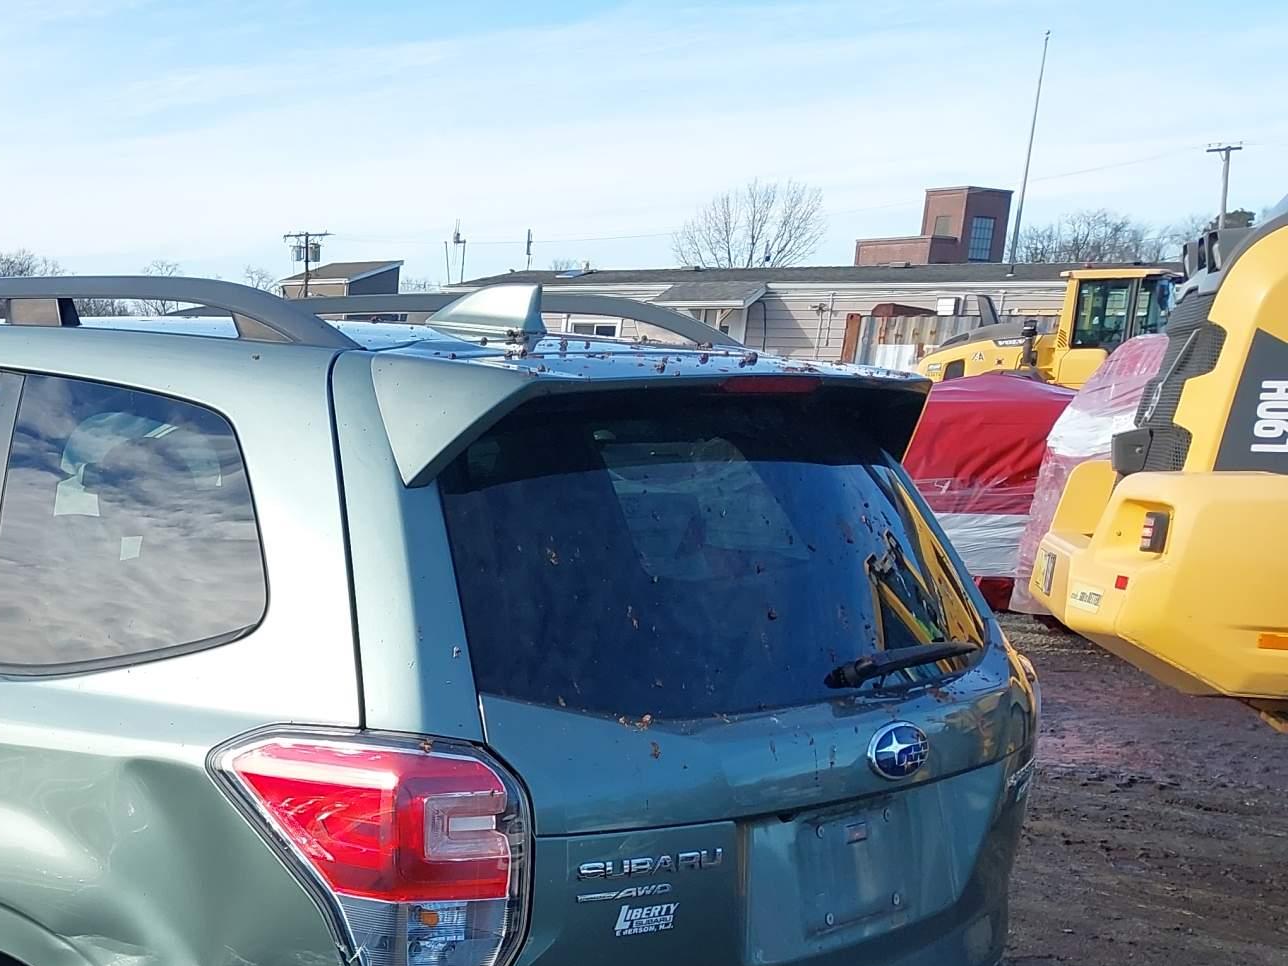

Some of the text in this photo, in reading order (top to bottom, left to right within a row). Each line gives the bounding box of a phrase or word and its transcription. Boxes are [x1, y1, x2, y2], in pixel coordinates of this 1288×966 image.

[578, 848, 723, 881] SUBARU
[614, 883, 672, 900] AWD
[614, 902, 680, 930] LIBERTY
